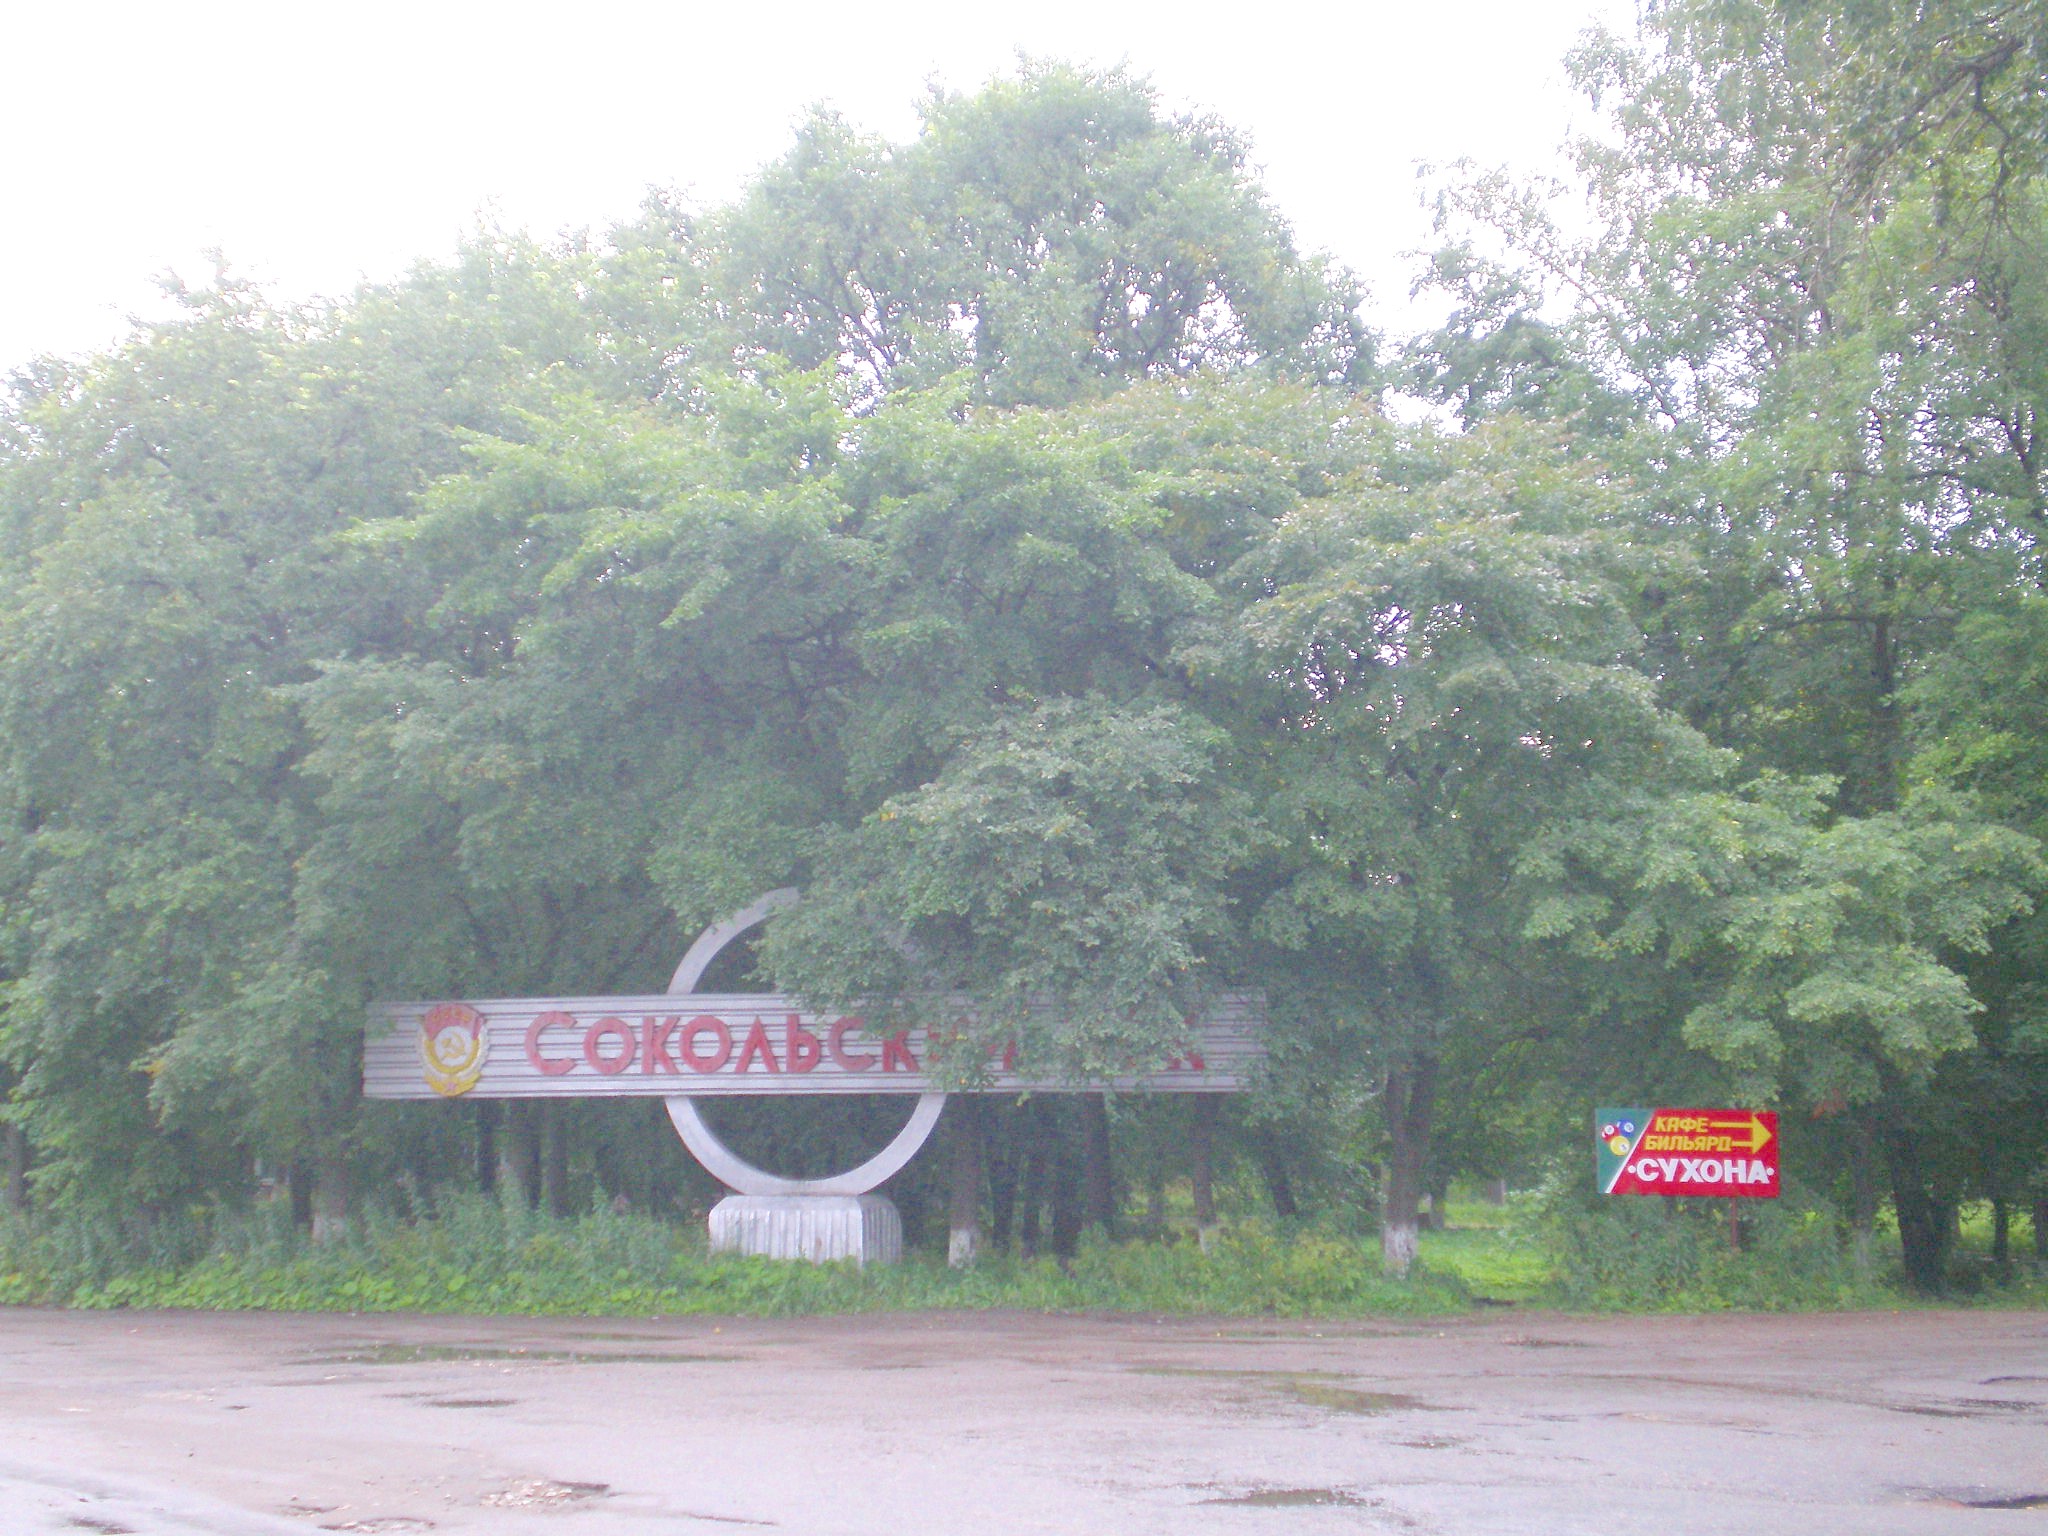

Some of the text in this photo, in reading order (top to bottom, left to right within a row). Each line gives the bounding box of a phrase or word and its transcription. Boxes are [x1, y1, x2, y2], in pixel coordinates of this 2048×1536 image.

[524, 1010, 1017, 1076] СОКОЛЬСК
[1655, 1116, 1709, 1133] КАФЕ
[1644, 1135, 1732, 1152] БИЛЬЯРД
[1636, 1158, 1770, 1185] СУХОНА
